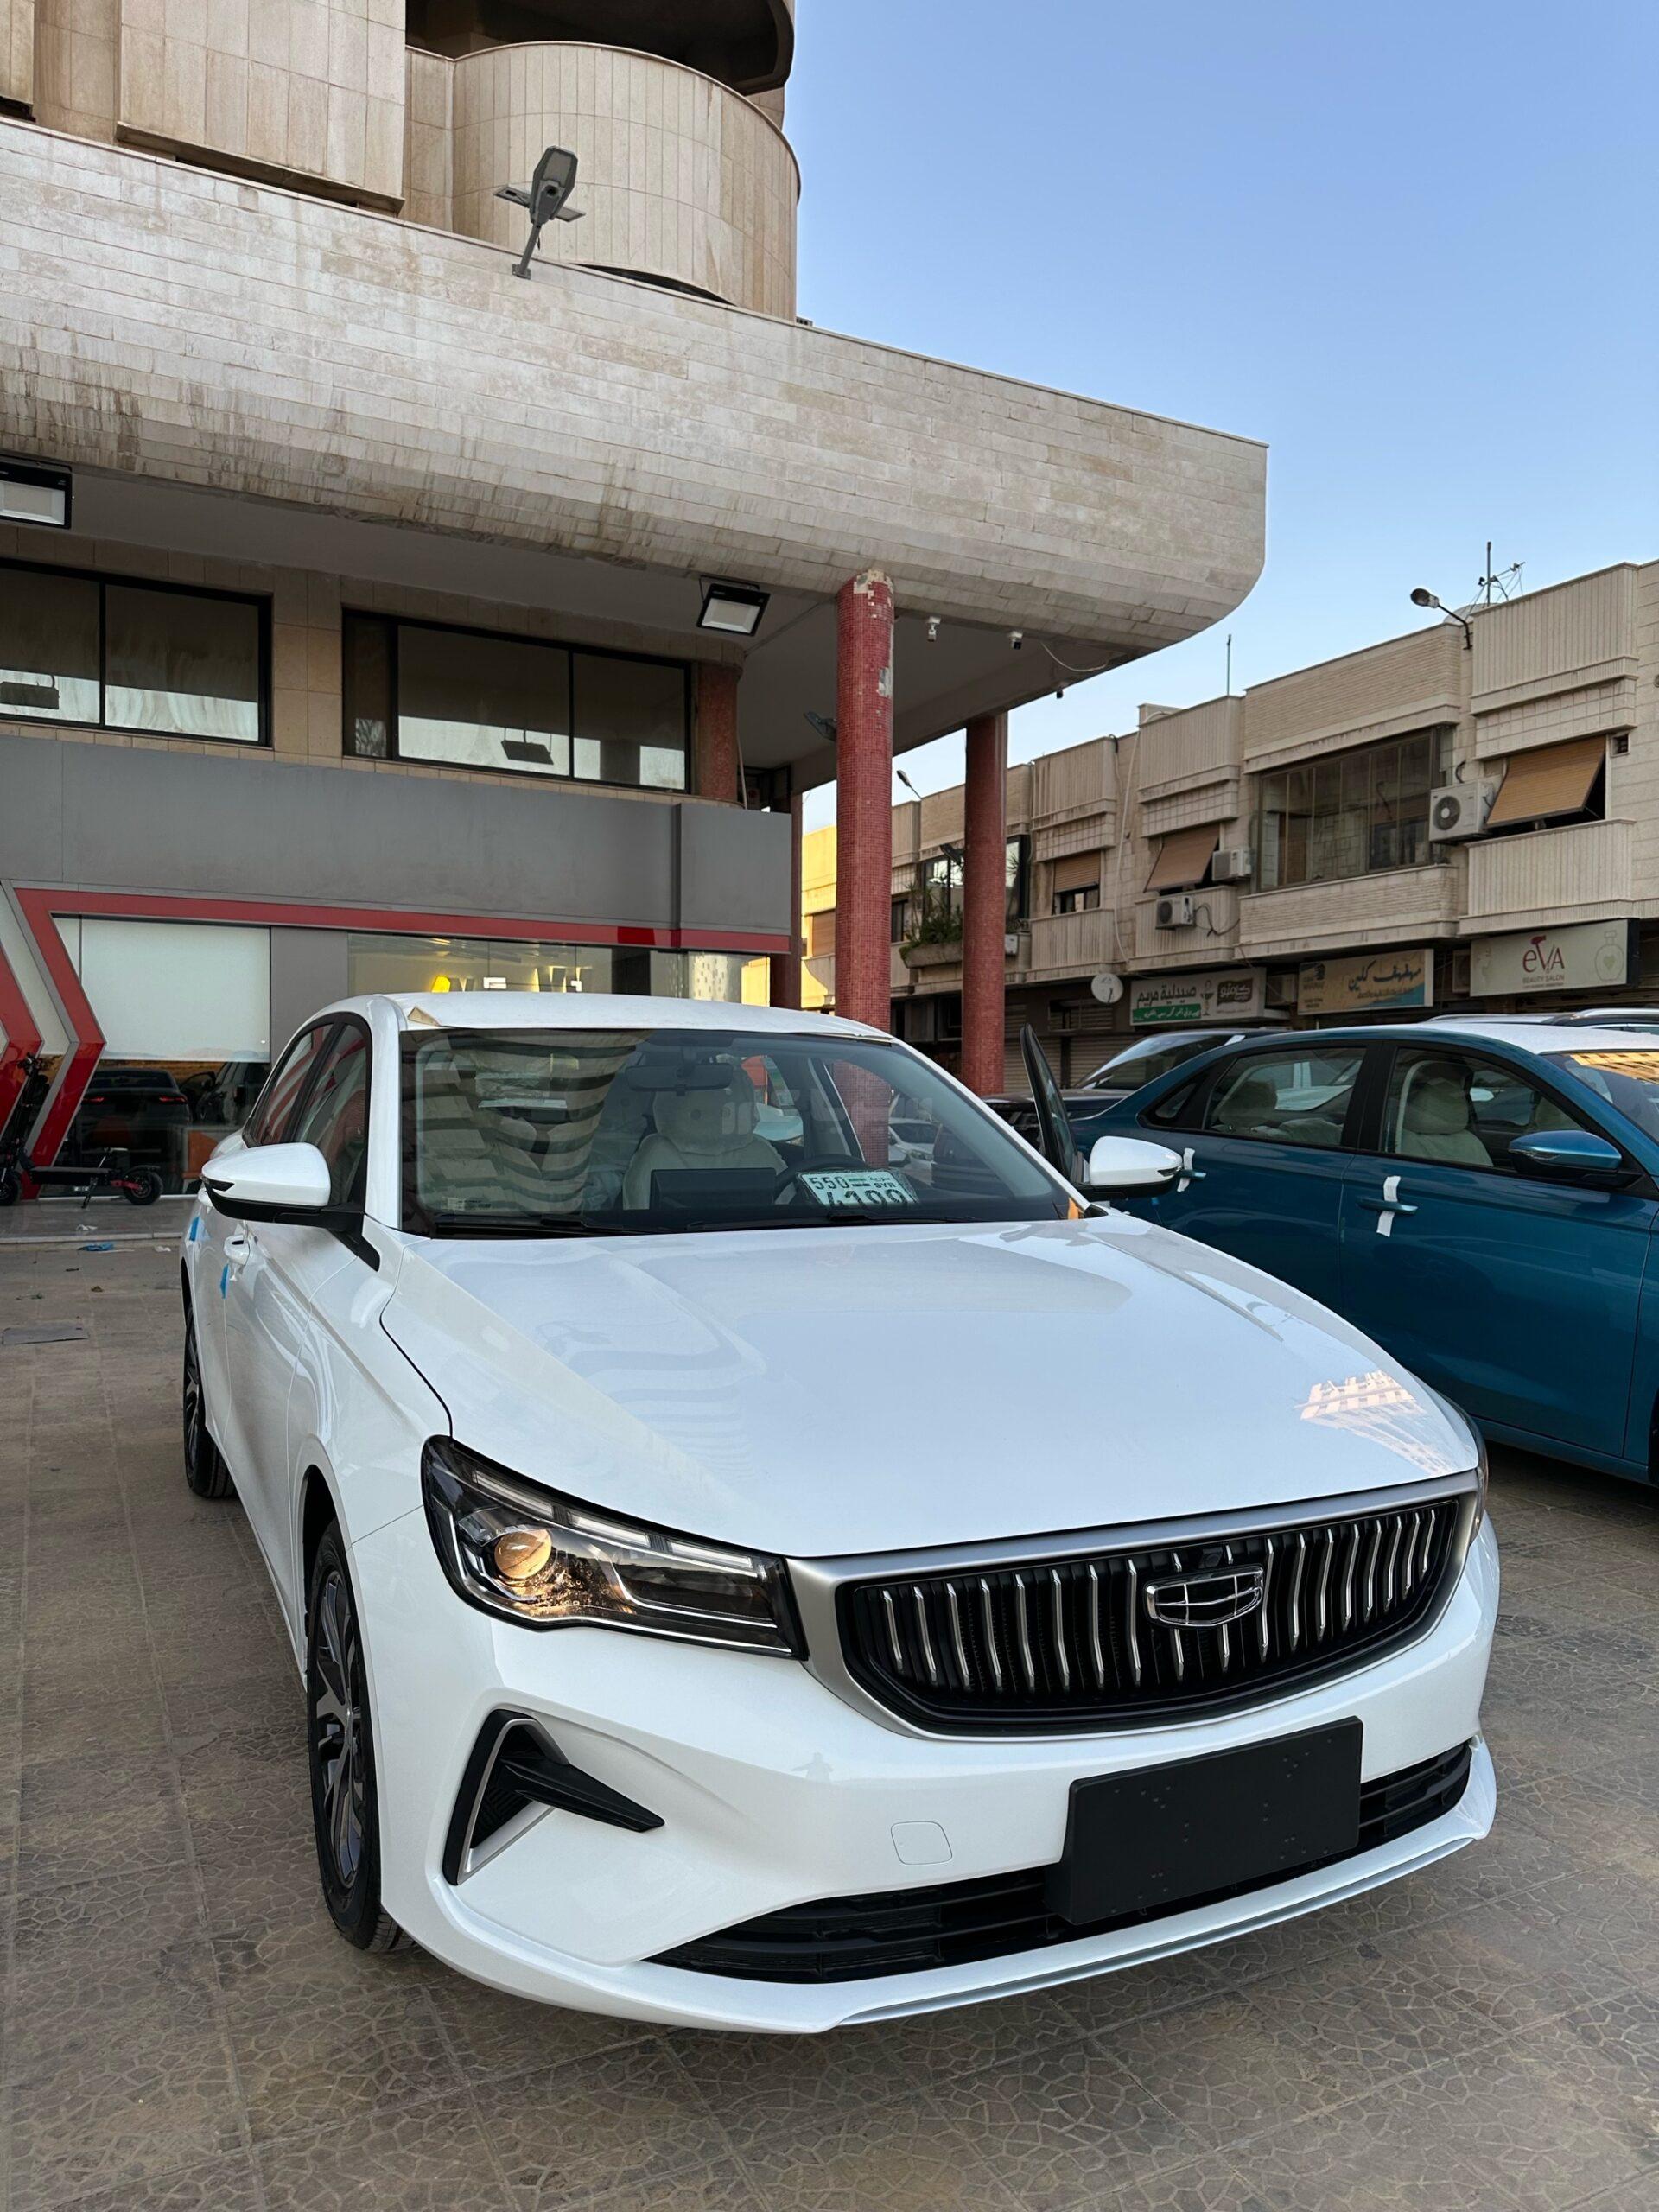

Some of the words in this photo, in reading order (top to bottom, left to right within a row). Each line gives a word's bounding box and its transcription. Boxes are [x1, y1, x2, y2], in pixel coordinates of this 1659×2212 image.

[1522, 976, 1543, 984] BEAUTY
[1545, 974, 1565, 982] SALON
[1137, 990, 1160, 1009] مريم
[1160, 983, 1197, 1005] صيدلية
[809, 1176, 849, 1190] 550
